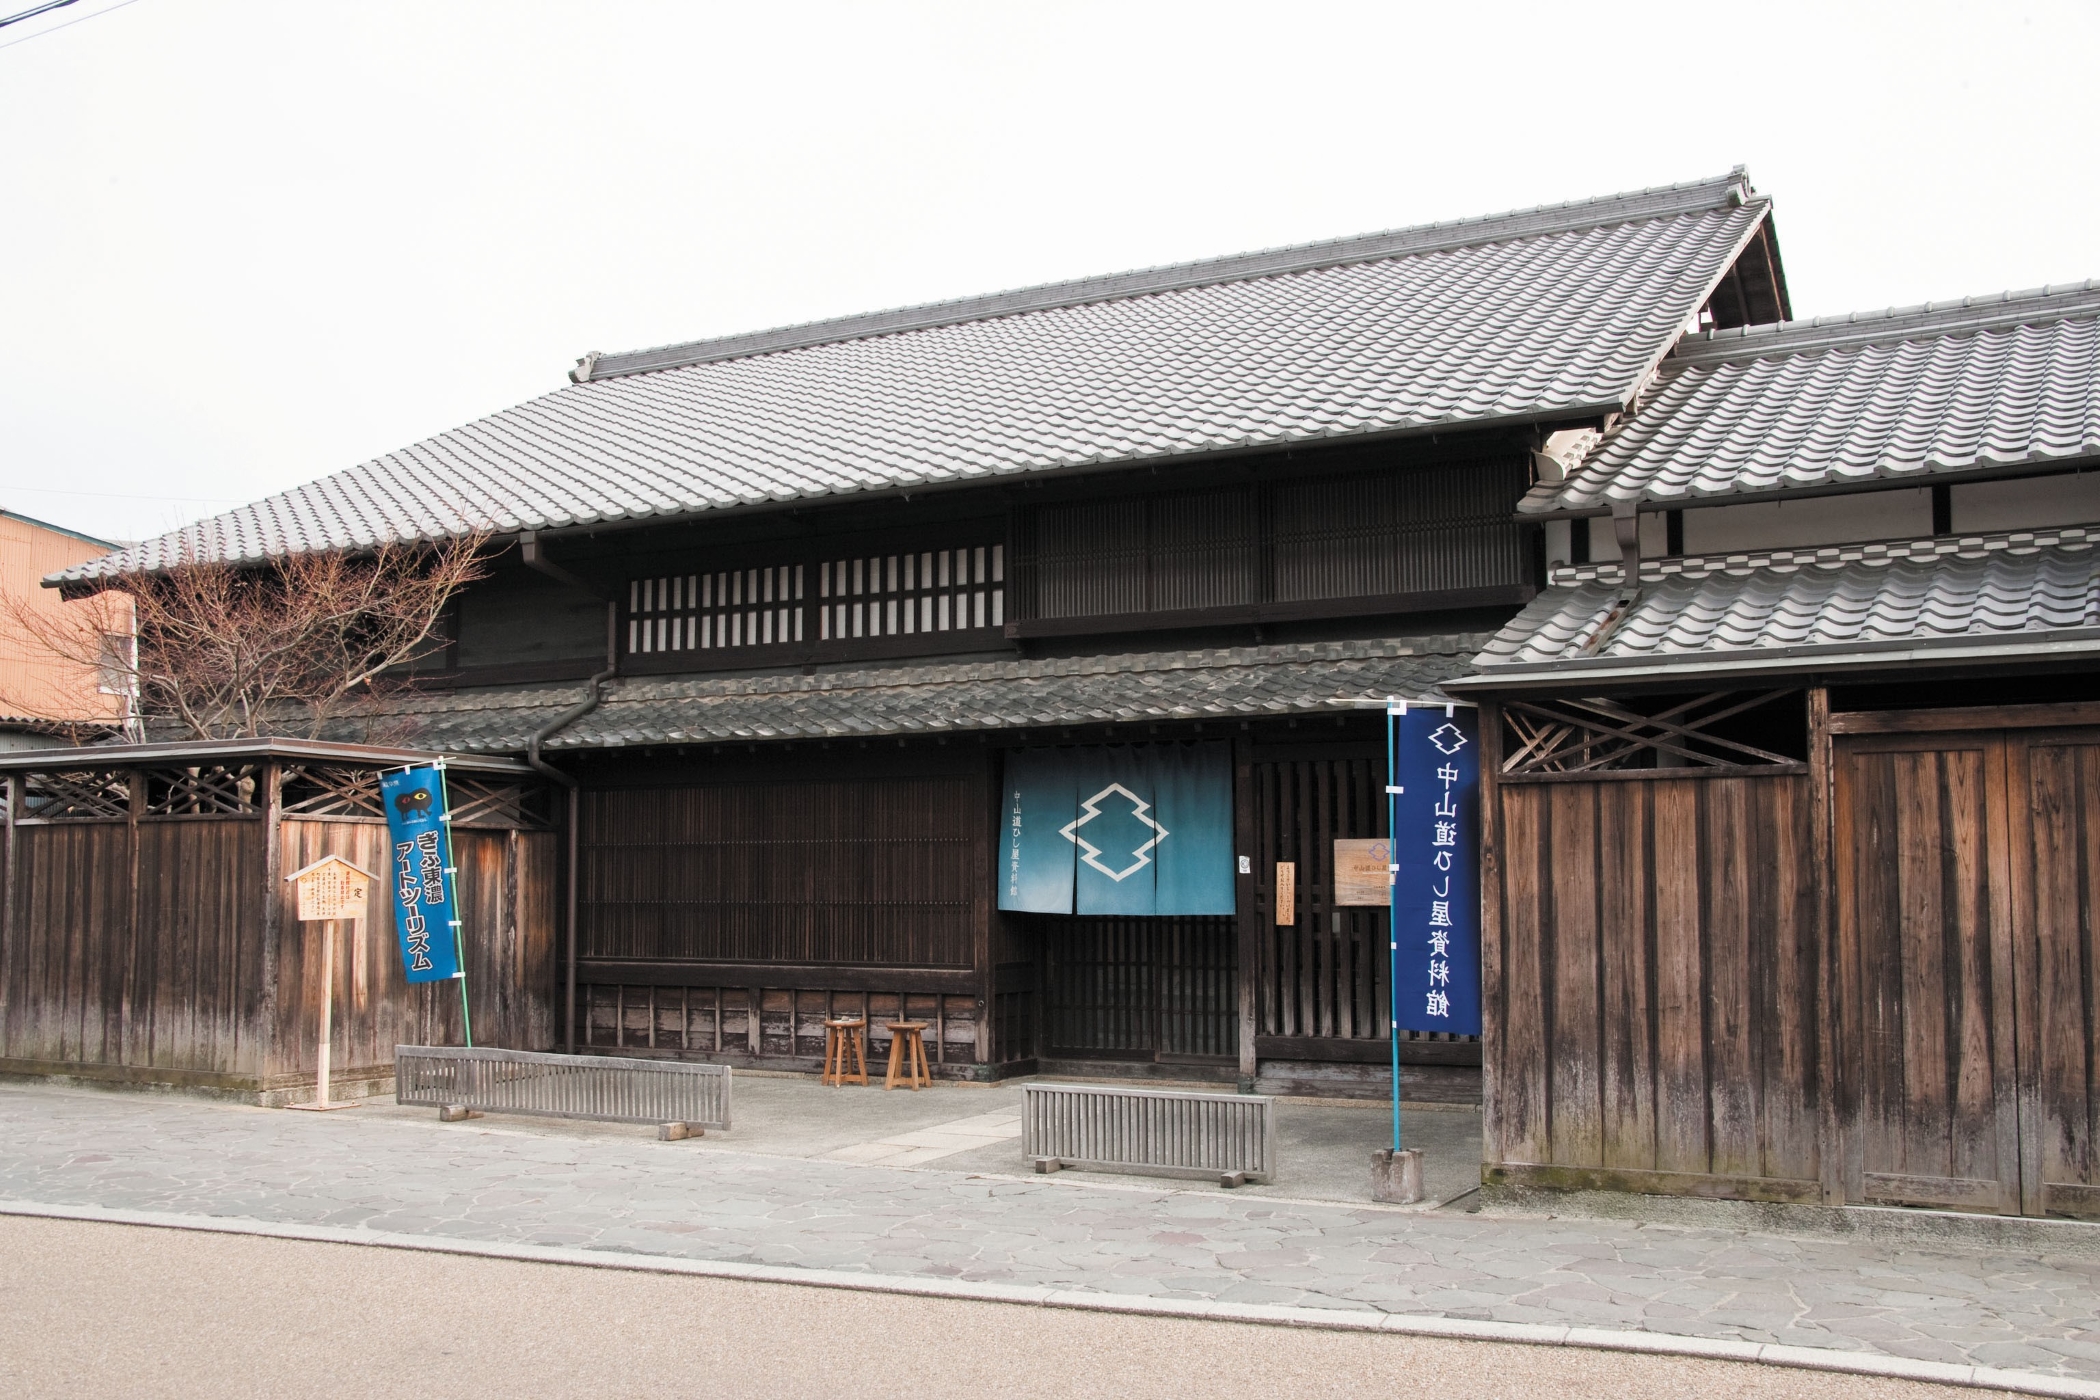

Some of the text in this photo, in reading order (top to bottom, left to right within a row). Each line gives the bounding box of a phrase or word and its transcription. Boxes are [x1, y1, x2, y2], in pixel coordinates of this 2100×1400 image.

[416, 830, 444, 904] ぎふ東濃
[1010, 790, 1022, 896] 中山道ひし屋資料館
[353, 887, 363, 898] 定
[396, 839, 433, 972] アートツーリズム
